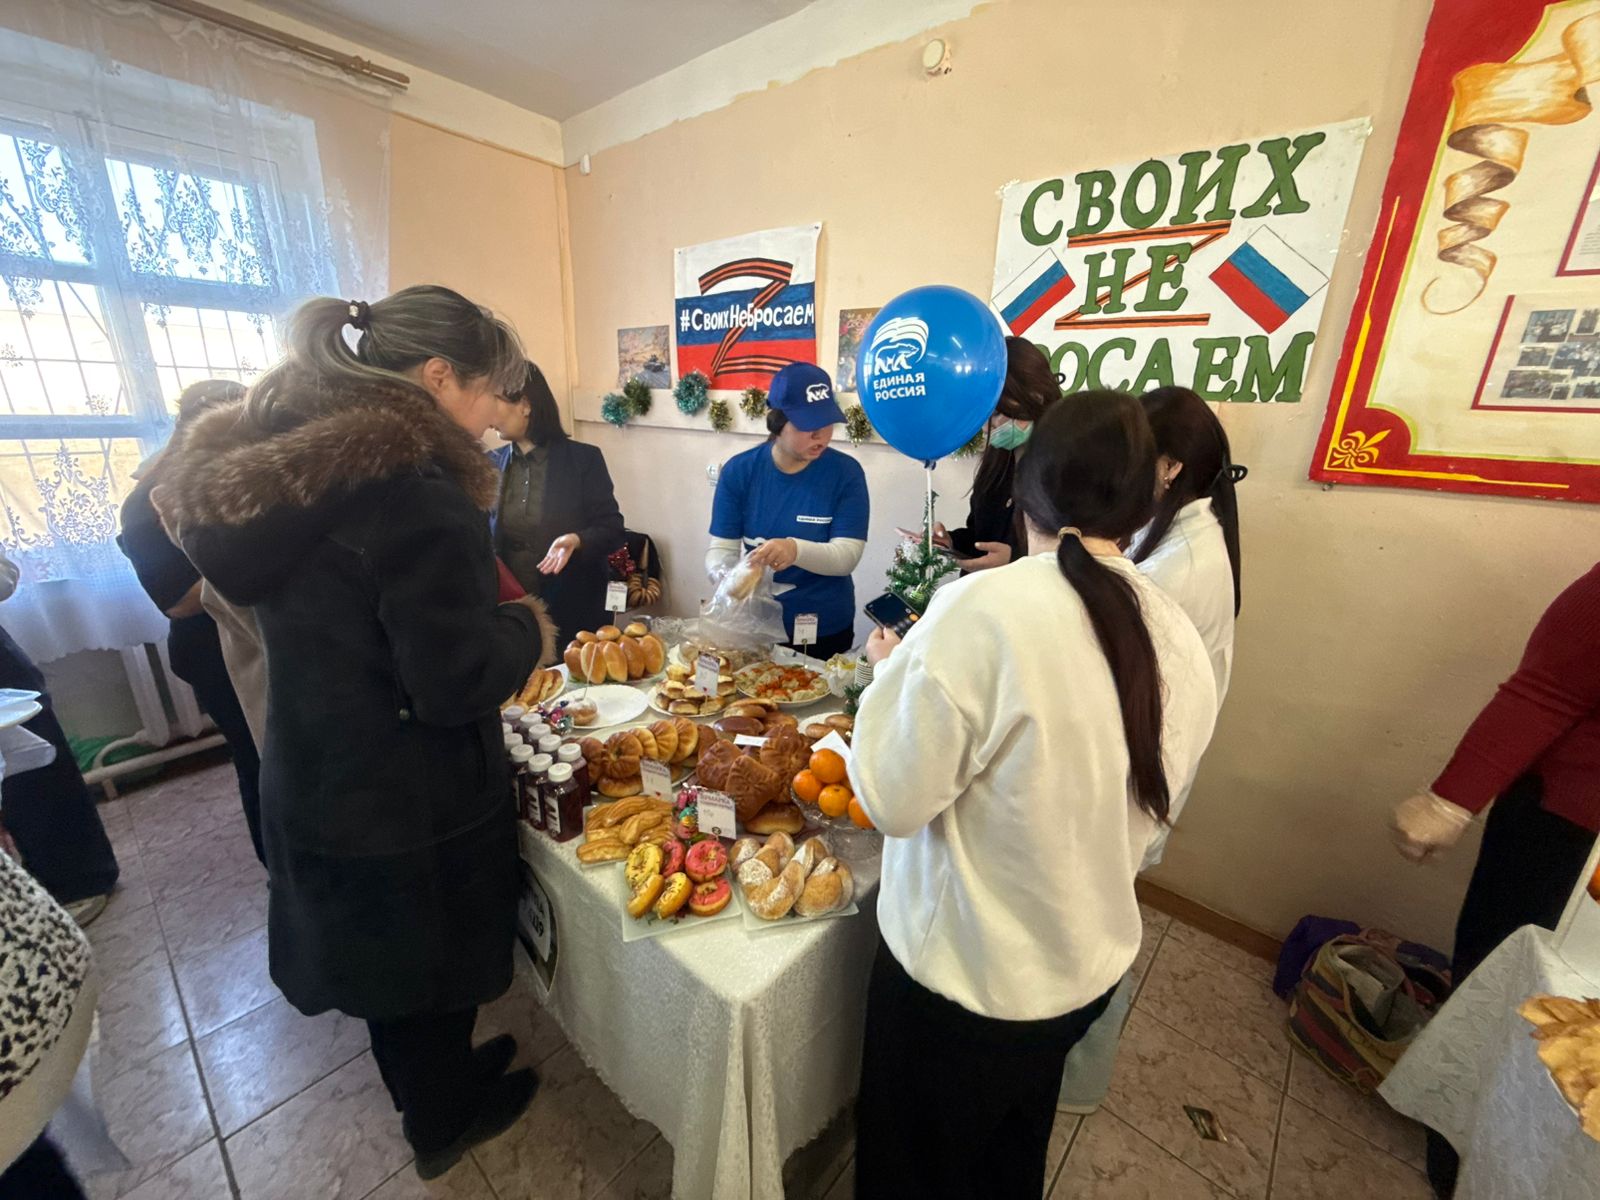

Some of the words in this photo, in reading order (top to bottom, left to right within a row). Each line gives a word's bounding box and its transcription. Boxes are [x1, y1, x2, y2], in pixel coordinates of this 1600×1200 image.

[1020, 132, 1326, 246] СВОИХ
[1078, 242, 1193, 314] НЕ
[873, 372, 925, 390] ЕДИНАЯ
[875, 385, 927, 402] РОССИЯ
[1034, 332, 1316, 403] ОСАЕМ
